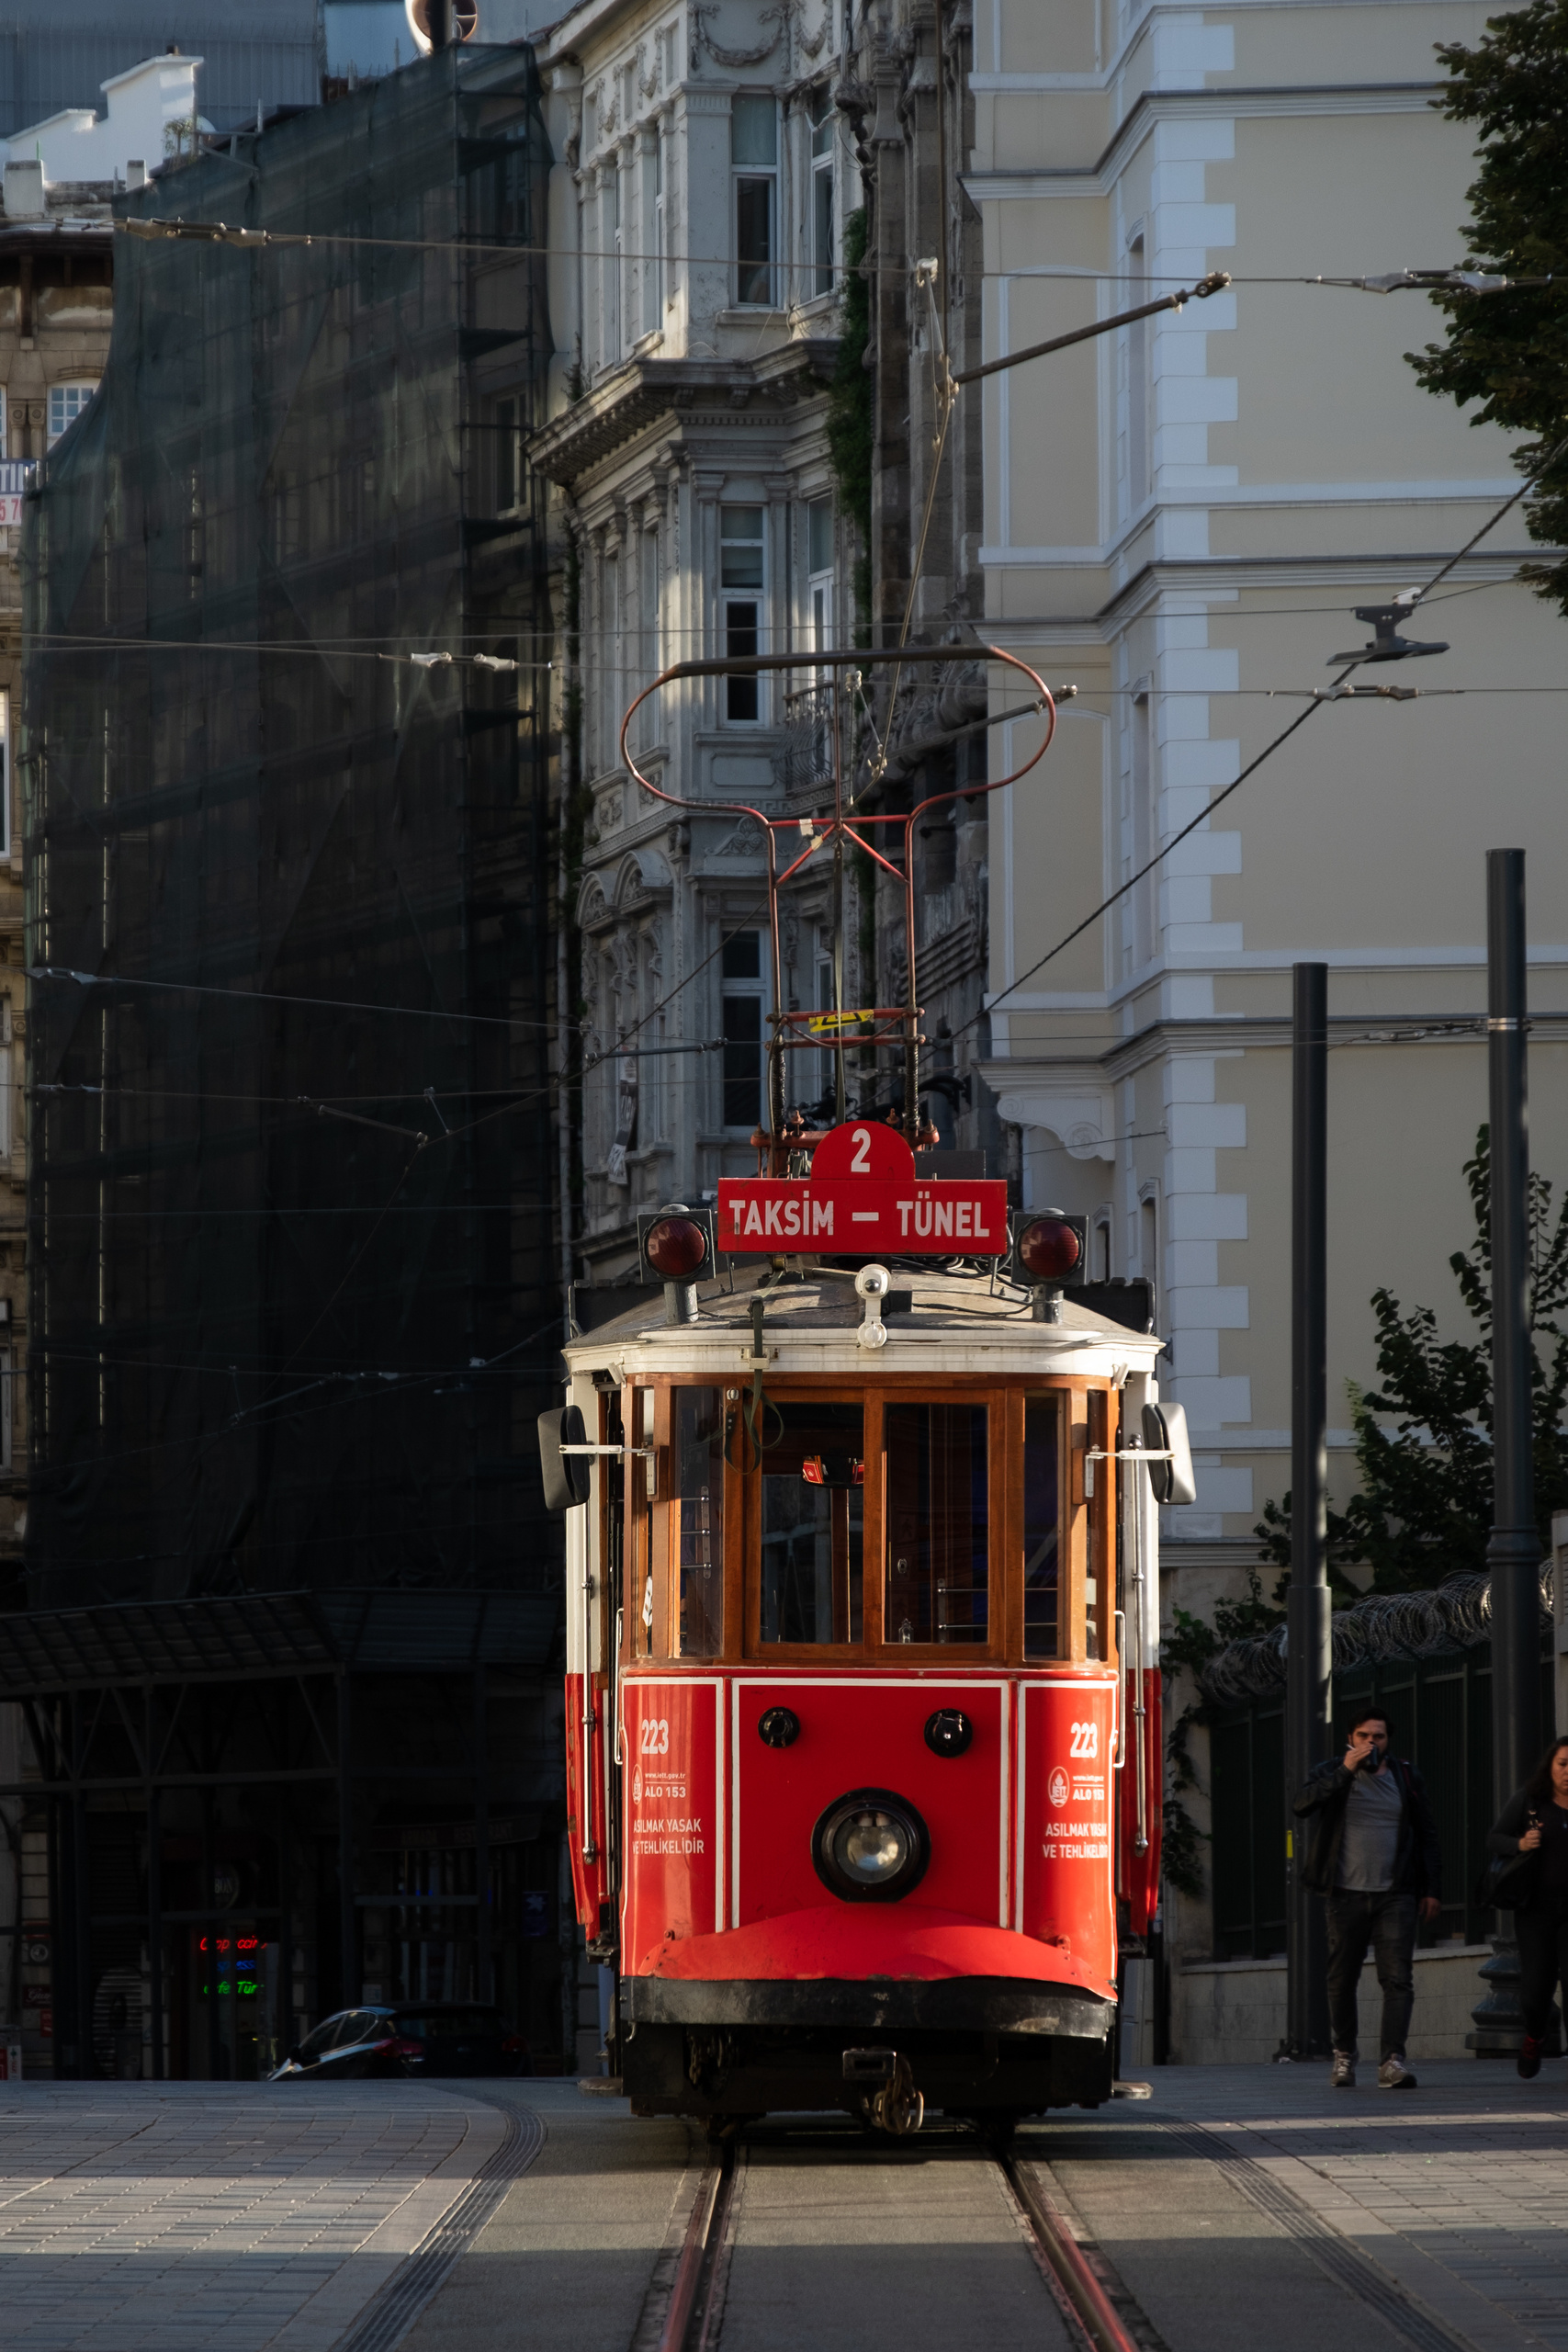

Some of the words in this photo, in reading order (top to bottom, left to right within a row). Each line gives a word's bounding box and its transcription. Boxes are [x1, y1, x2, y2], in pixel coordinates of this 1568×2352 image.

[851, 1128, 871, 1172] 2
[729, 1191, 834, 1236] TAKSİM
[897, 1191, 990, 1238] TÜNEL
[641, 1719, 669, 1755] 223
[1070, 1722, 1098, 1758] 223
[645, 1786, 662, 1798] ALO
[665, 1786, 686, 1798] 153
[1073, 1789, 1091, 1801] ALO
[633, 1819, 665, 1834] ASILMAK
[666, 1818, 701, 1833] YASAK
[1045, 1823, 1089, 1838] ASILMAK
[640, 1838, 705, 1855] TEHLİKELİDİR
[1043, 1844, 1056, 1858] VE
